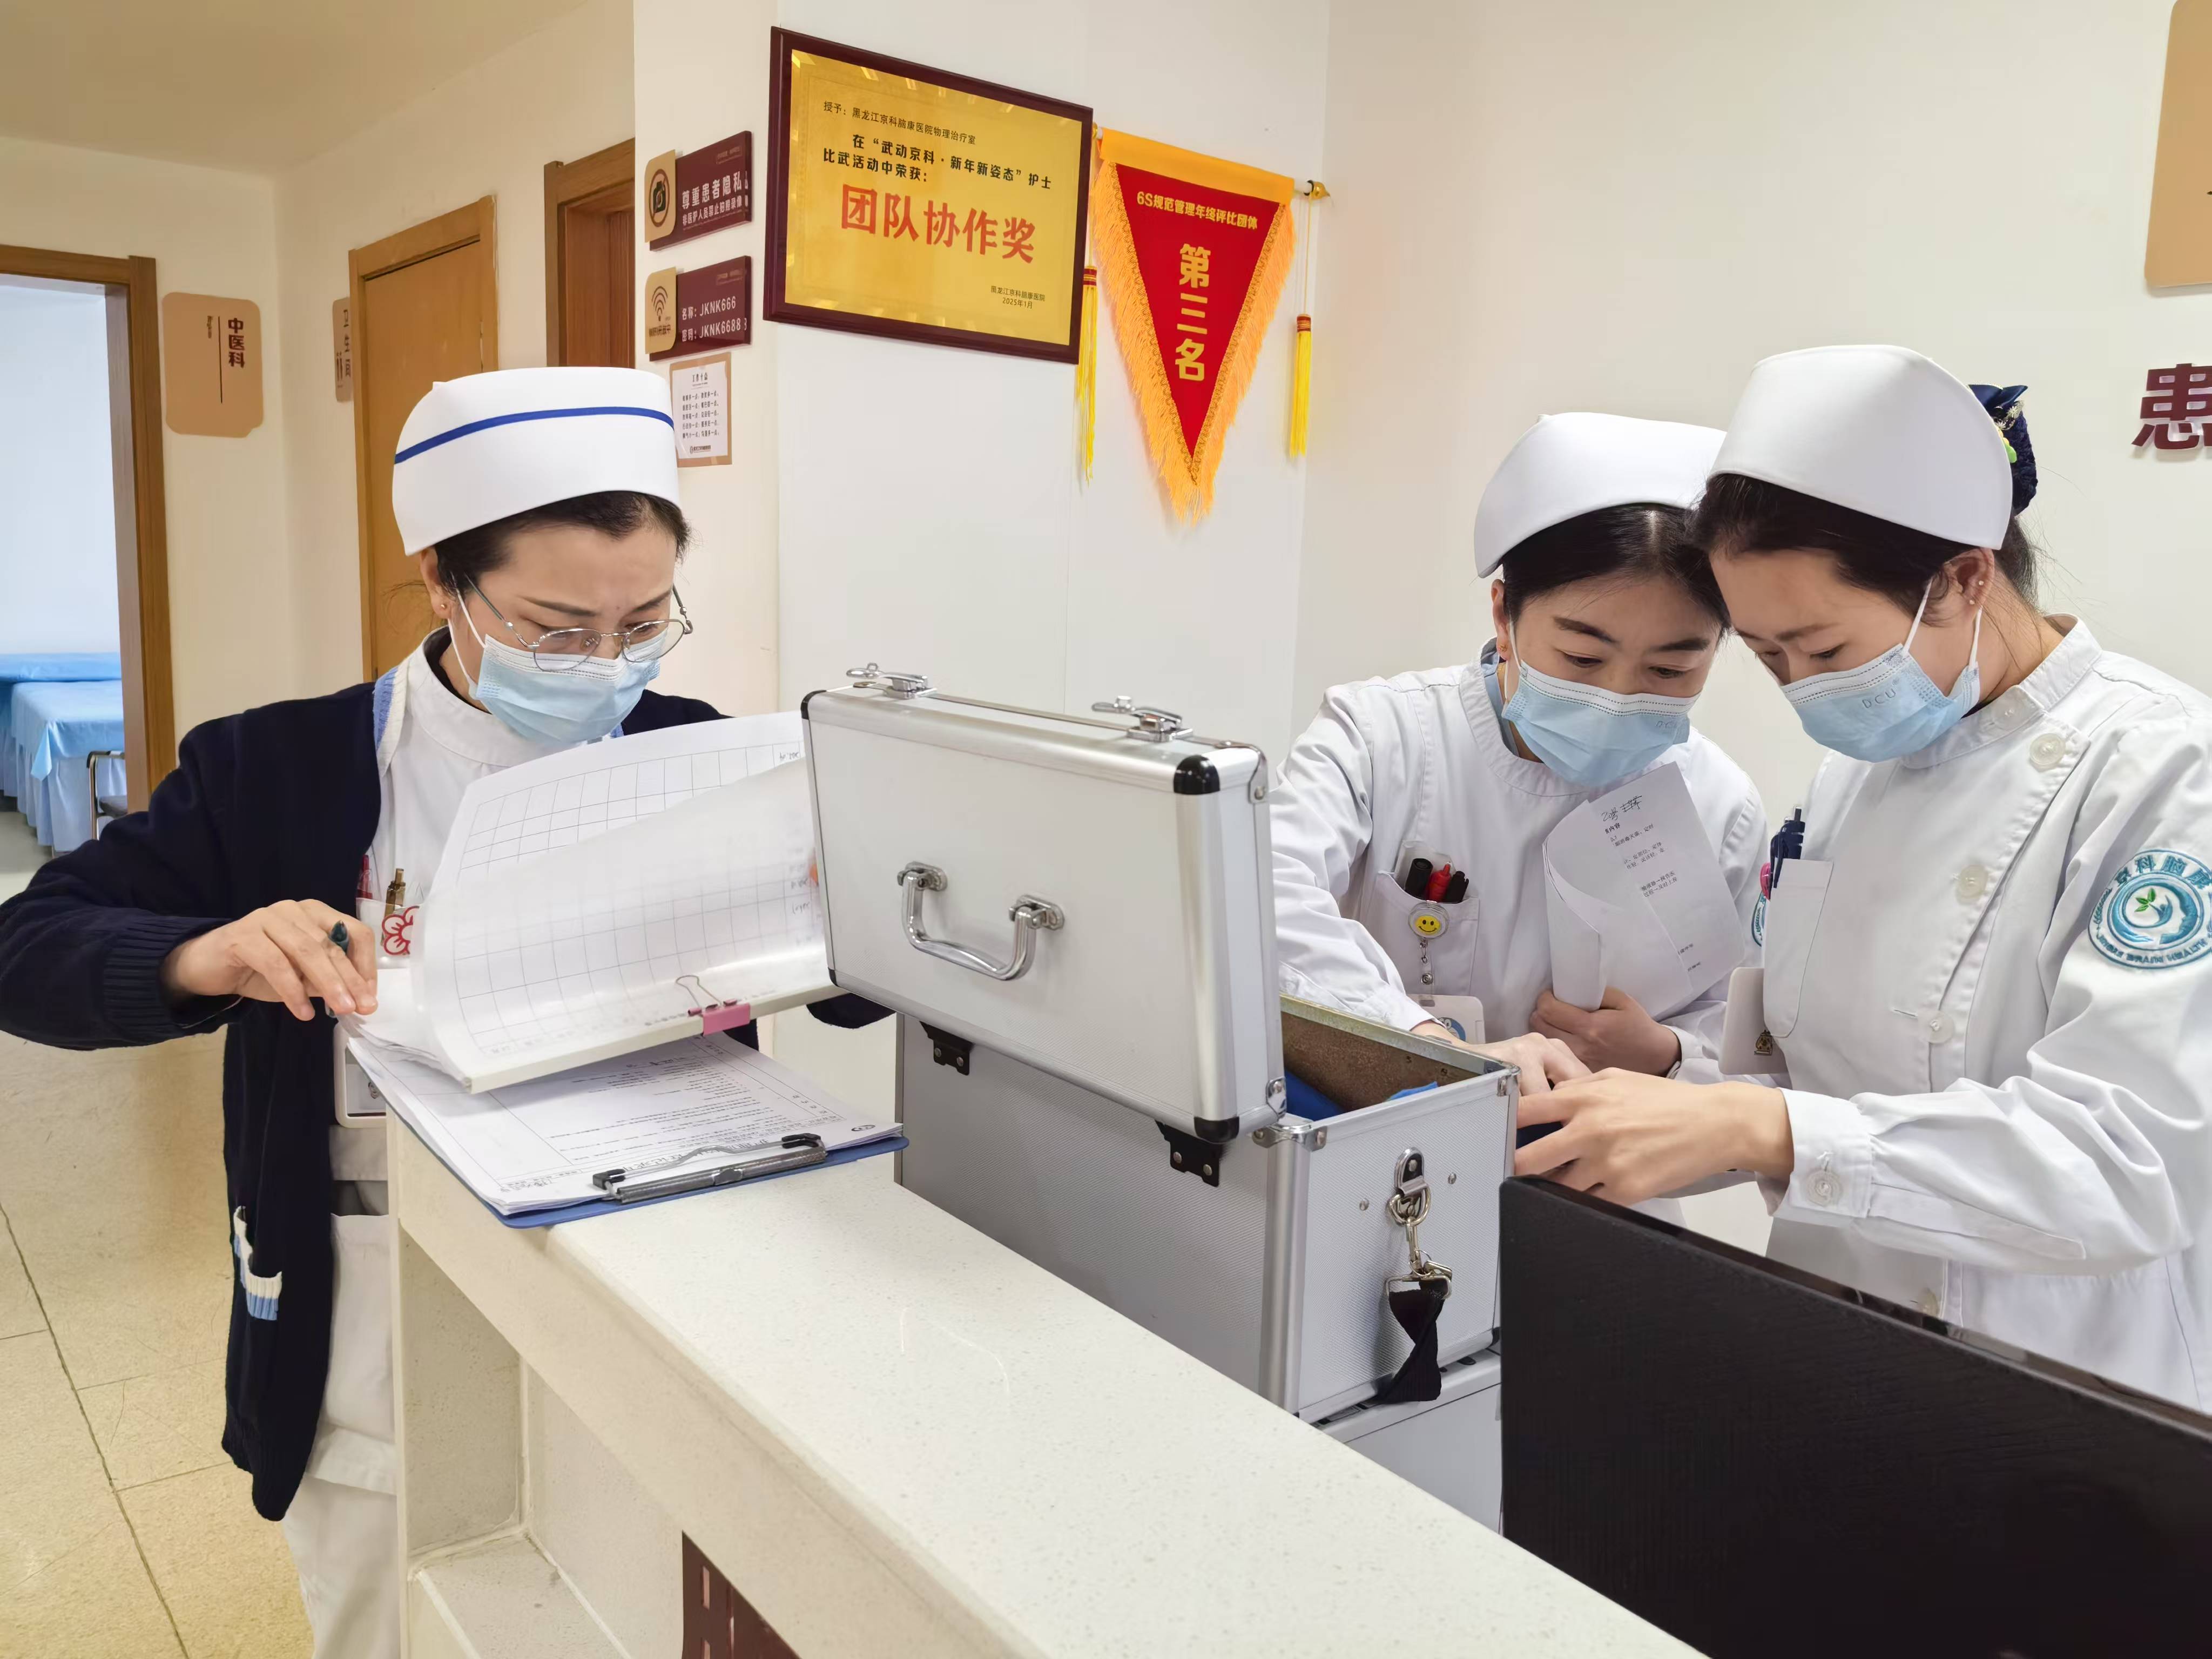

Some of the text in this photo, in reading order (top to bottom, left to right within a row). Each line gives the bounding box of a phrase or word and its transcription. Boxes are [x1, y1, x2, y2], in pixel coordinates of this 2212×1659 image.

[841, 184, 1036, 264] 团队协作奖
[1136, 191, 1258, 230] 6S规范管理年终评比团体
[1002, 297, 1033, 309] 2025年1月
[1175, 244, 1211, 381] 第三名
[227, 317, 245, 368] 中医科
